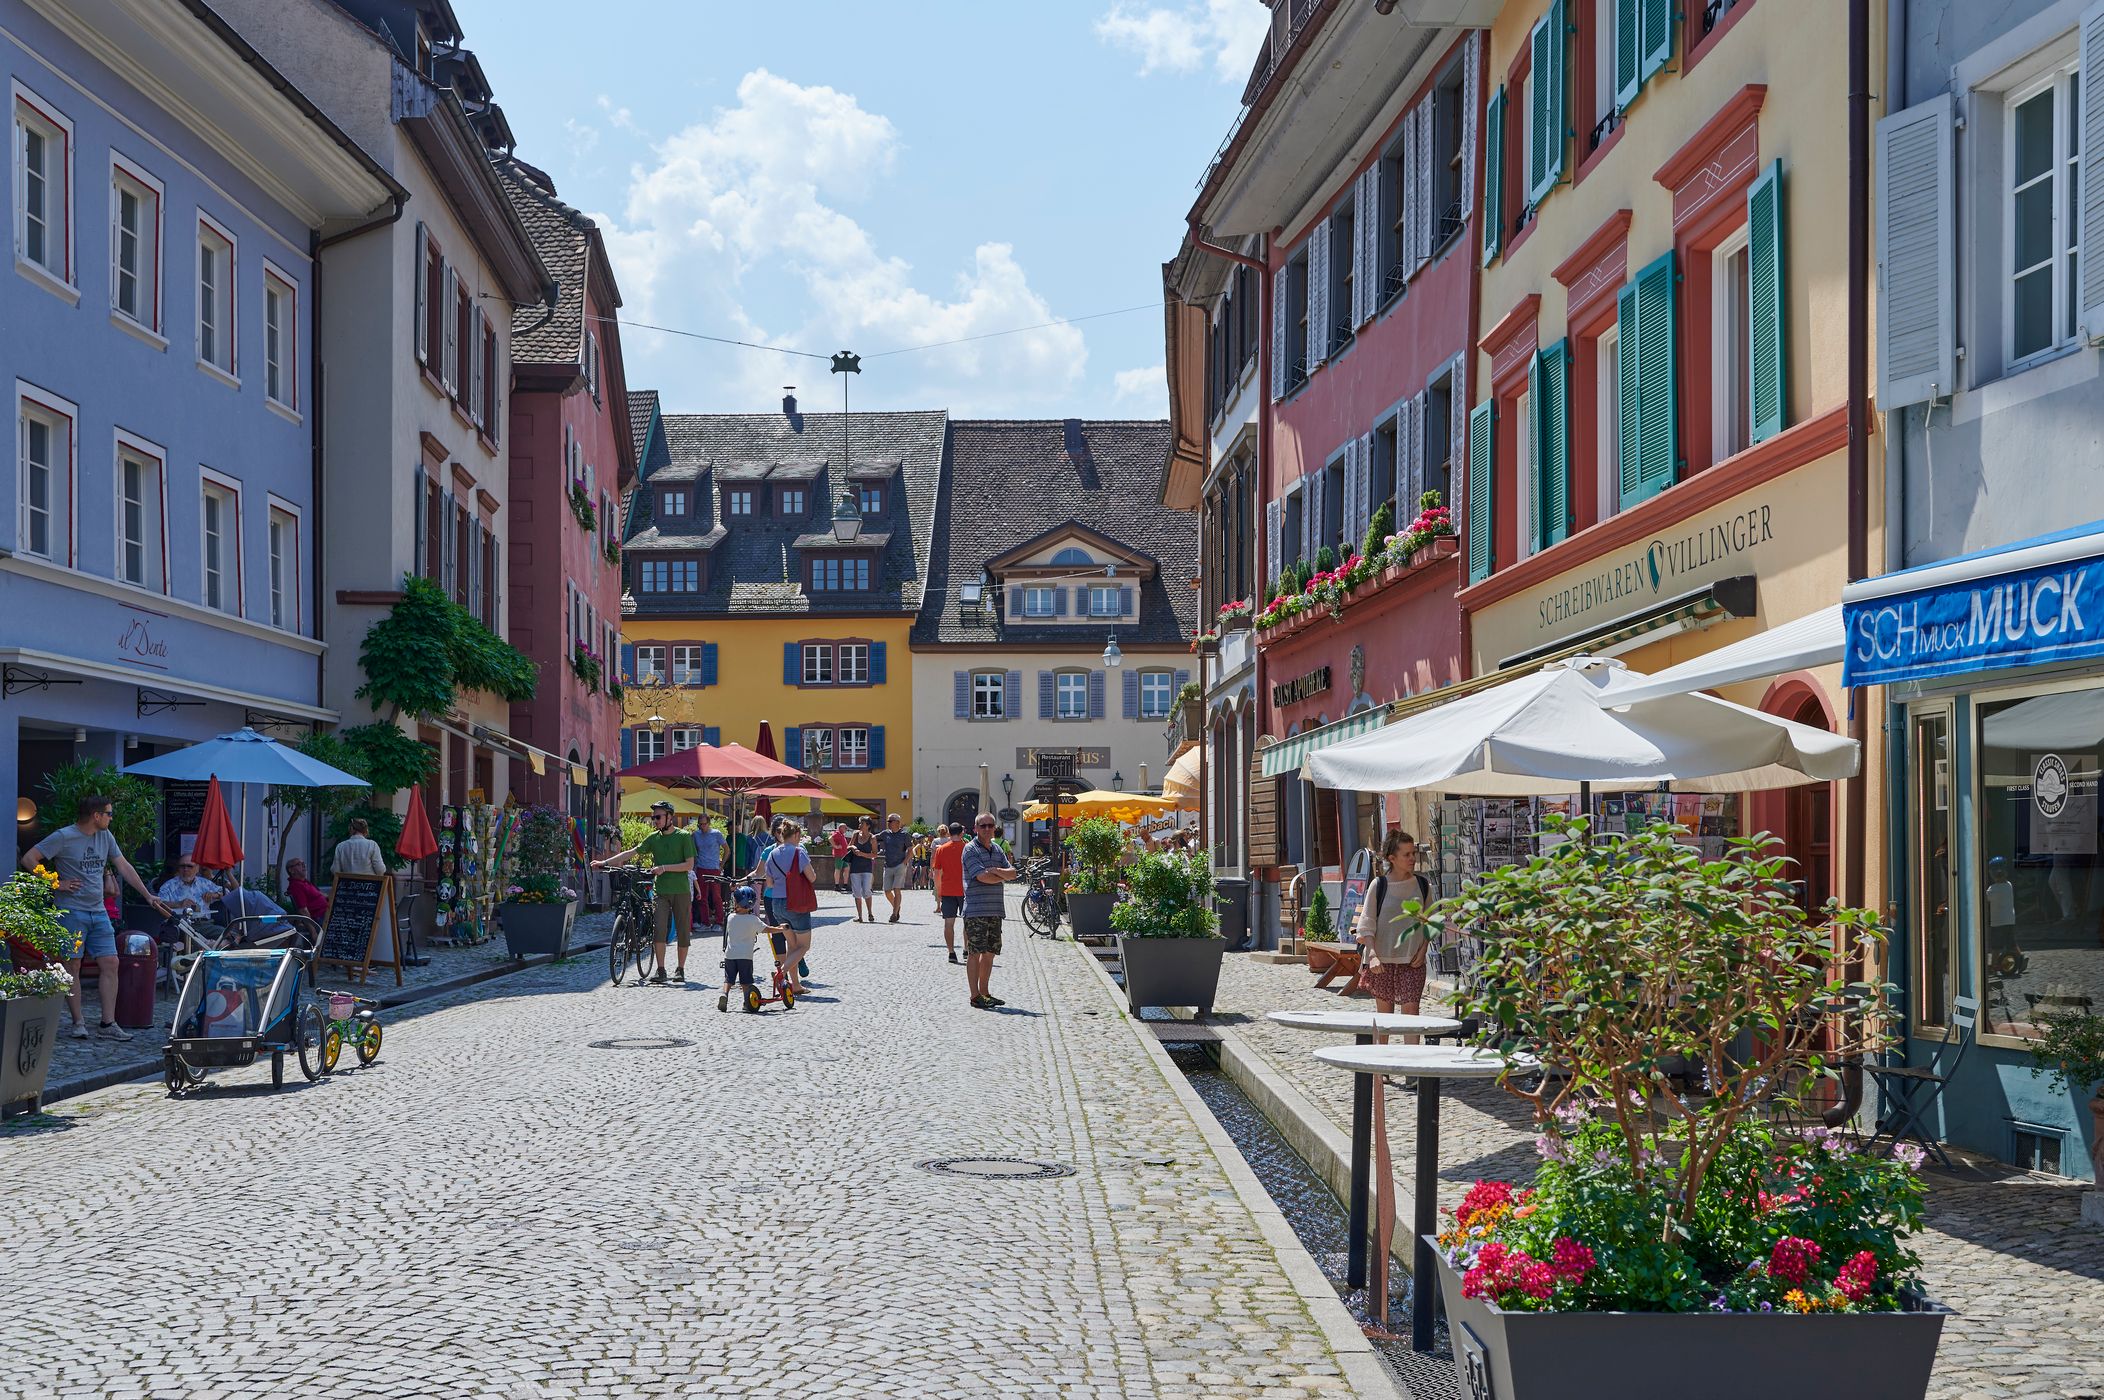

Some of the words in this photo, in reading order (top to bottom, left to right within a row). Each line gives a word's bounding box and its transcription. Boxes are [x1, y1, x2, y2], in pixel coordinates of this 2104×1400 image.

[1539, 557, 1646, 629] SCHREIBWAREN
[1667, 504, 1774, 577] VILLINGER
[1967, 570, 2087, 647] MUCK
[1041, 760, 1072, 776] Höfli
[2041, 800, 2061, 813] STAUFEN
